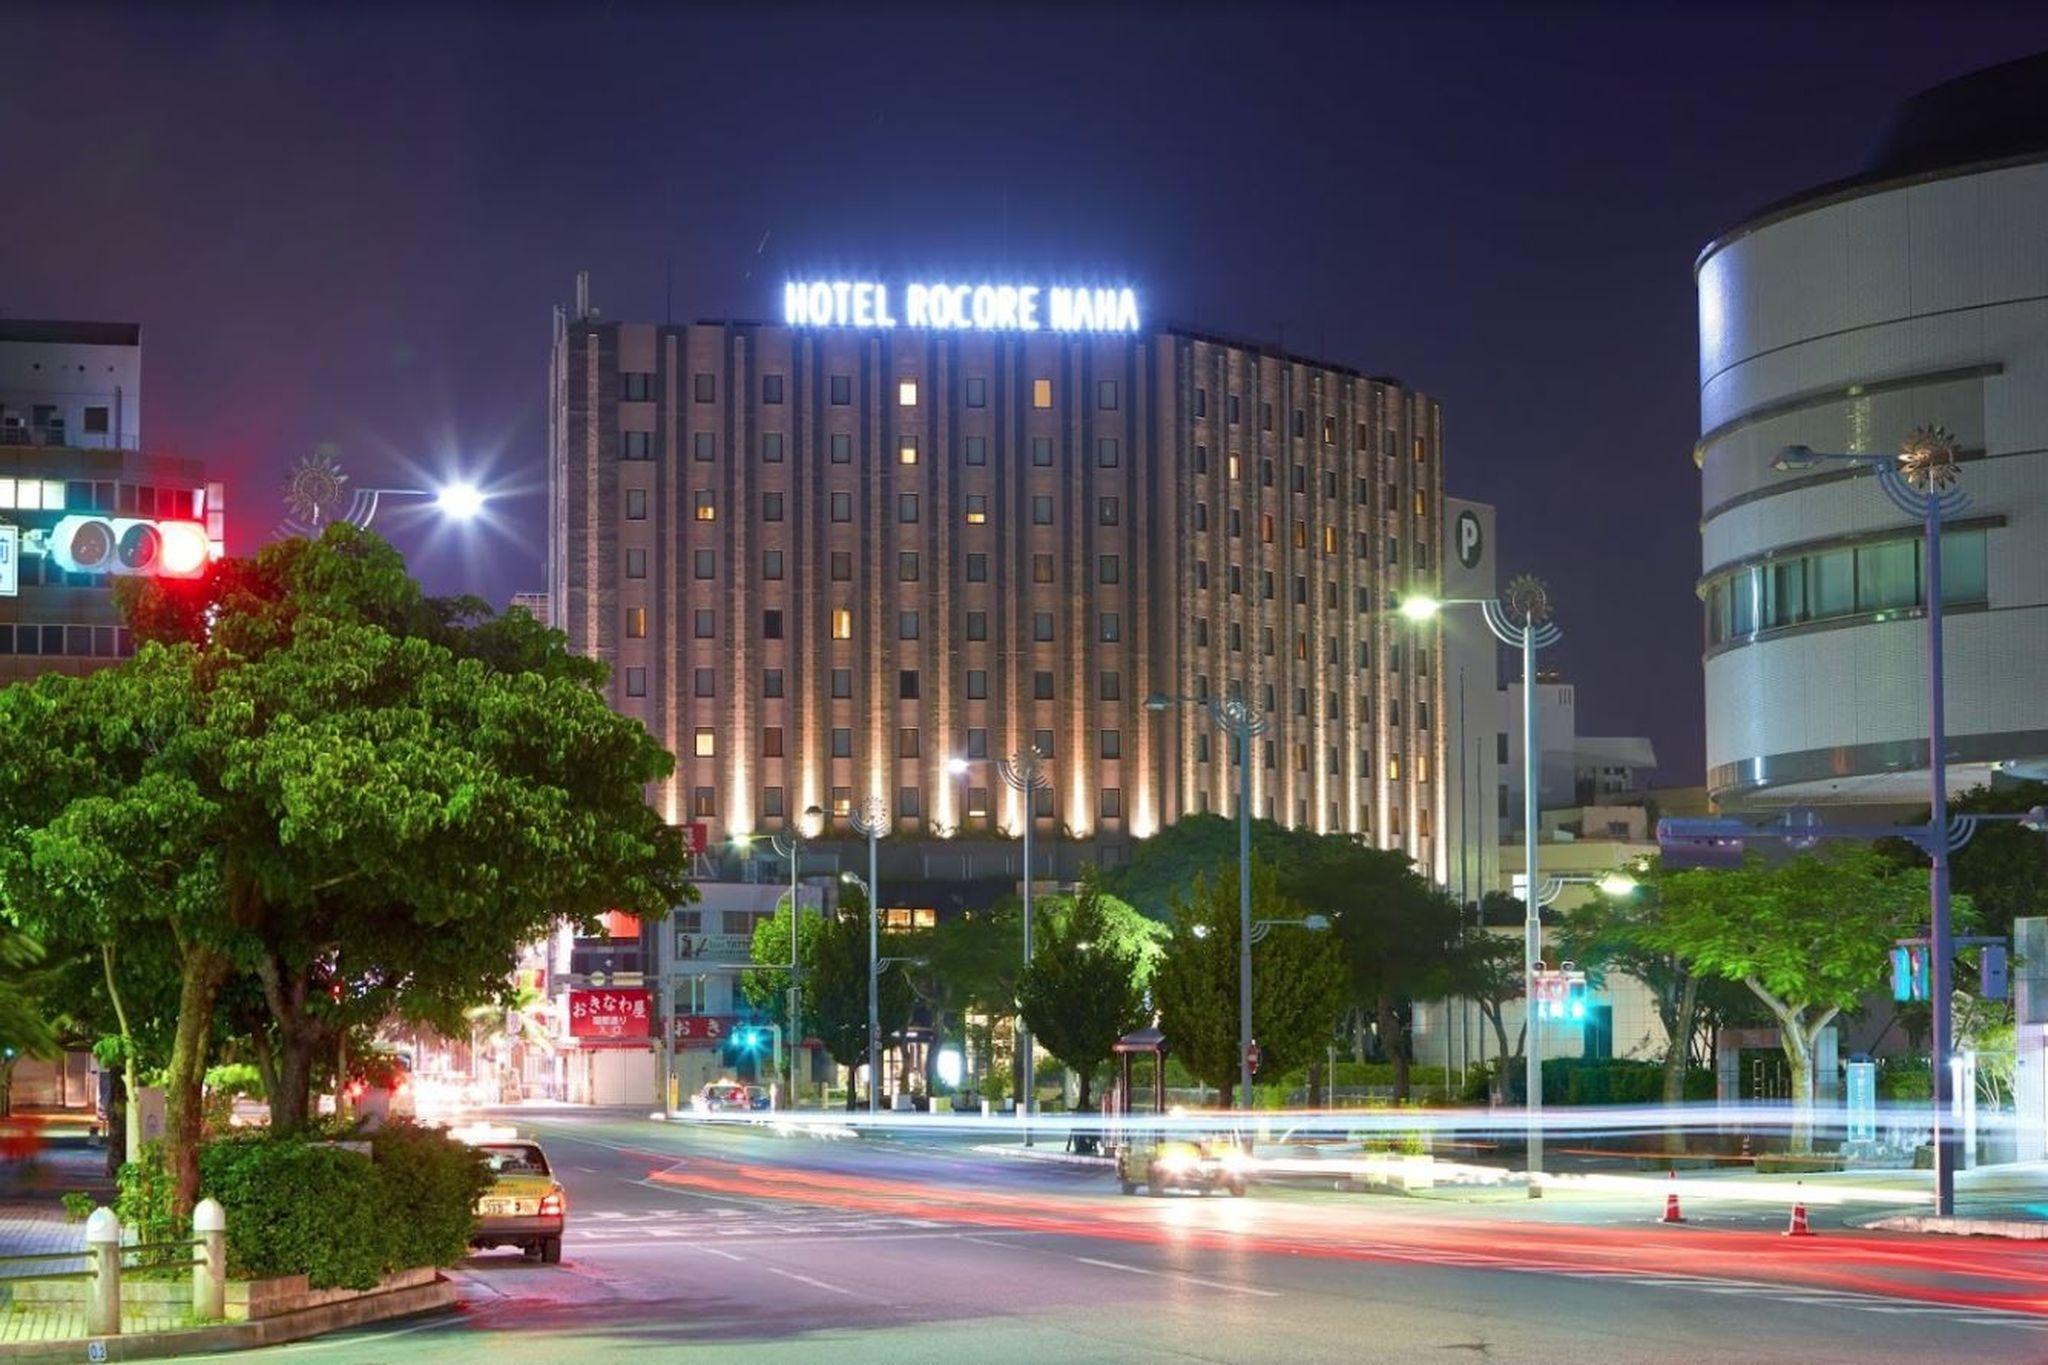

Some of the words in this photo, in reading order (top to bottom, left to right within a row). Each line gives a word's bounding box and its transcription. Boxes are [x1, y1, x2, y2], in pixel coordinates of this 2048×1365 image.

[785, 281, 896, 327] HOTEL
[907, 284, 1040, 329] ROCORE
[1050, 287, 1139, 331] NAHA
[1461, 518, 1478, 560] P
